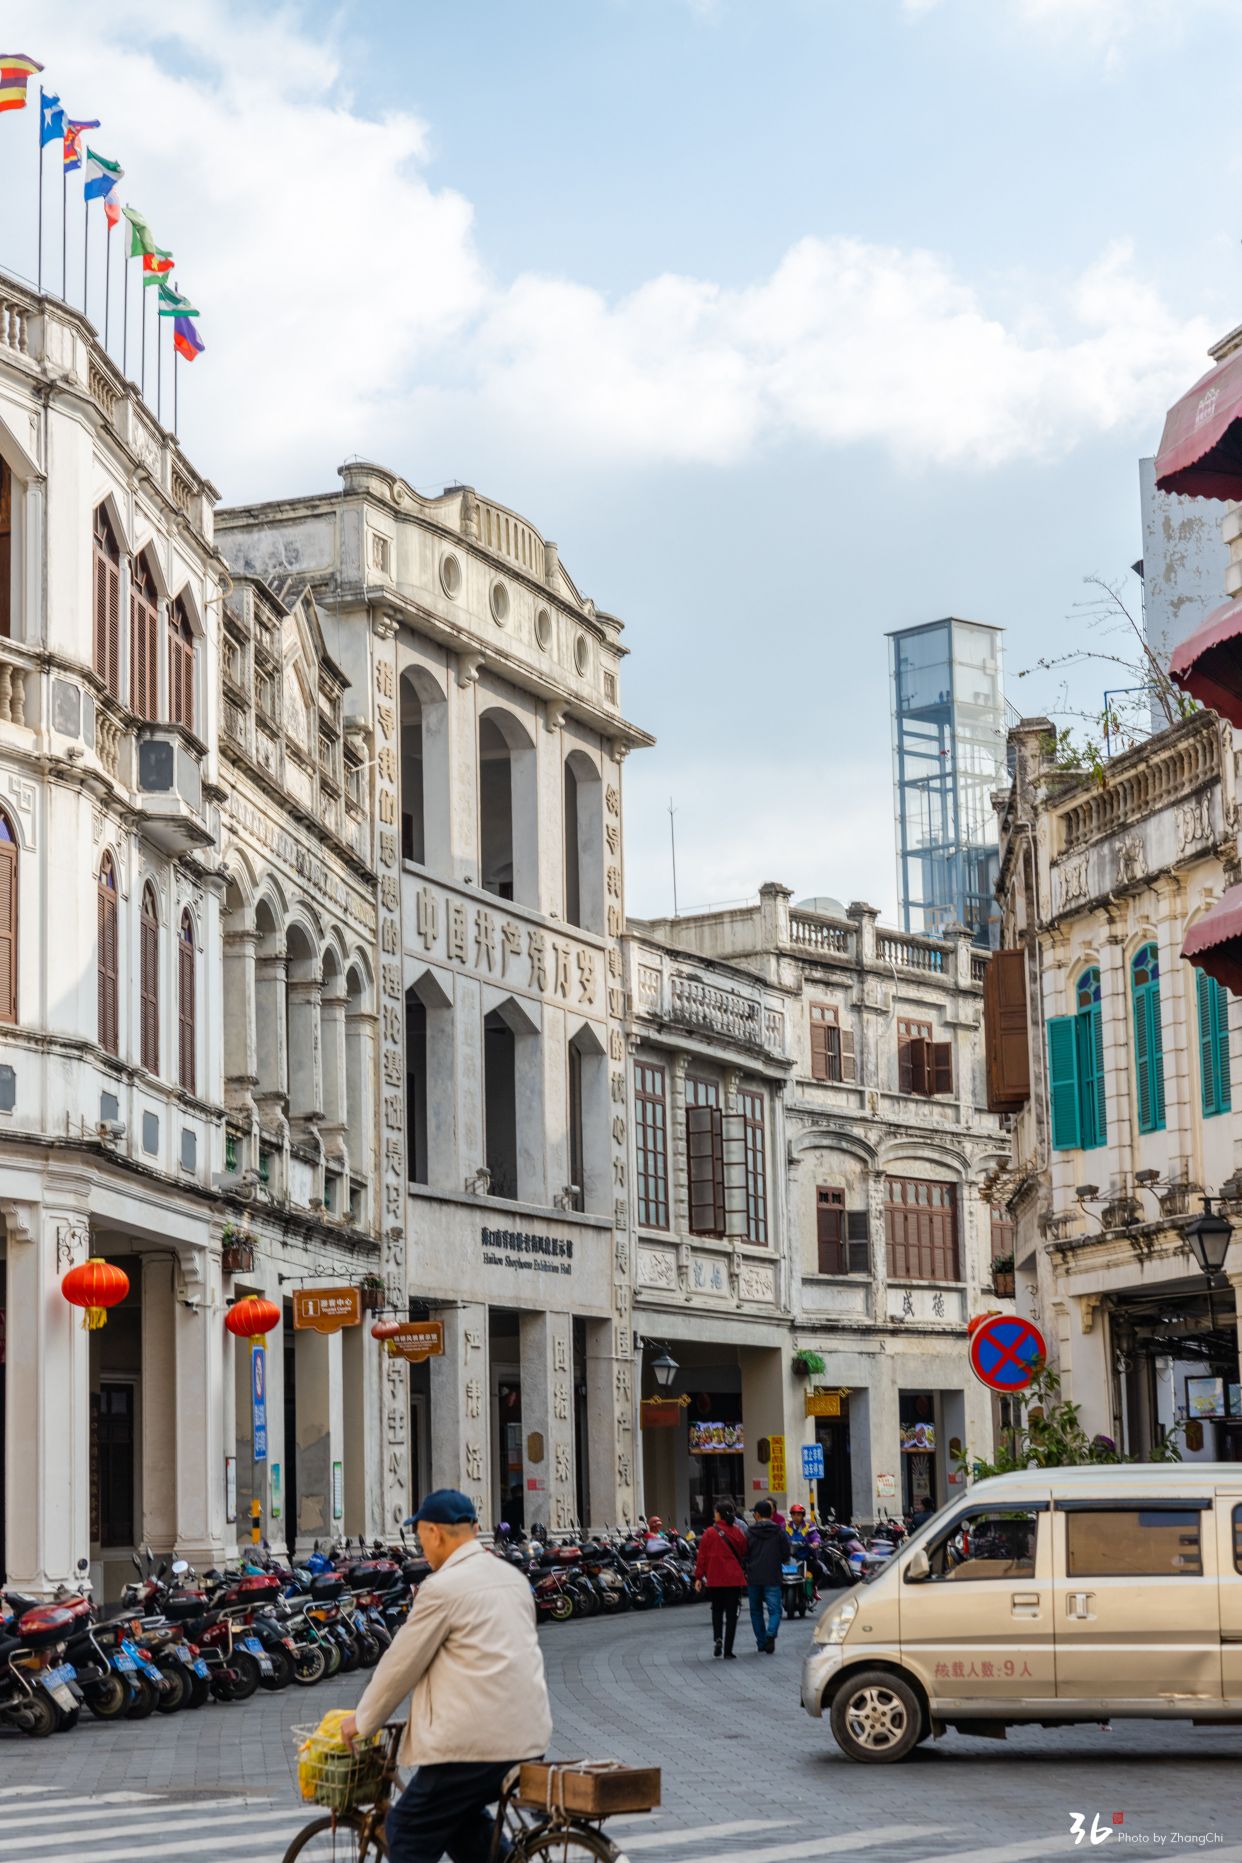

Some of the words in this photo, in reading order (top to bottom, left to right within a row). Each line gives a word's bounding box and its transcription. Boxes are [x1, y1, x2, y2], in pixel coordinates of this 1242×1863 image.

[376, 659, 404, 1524] 指导我们思想的理论基础是马克思宁主义。
[416, 886, 597, 1004] 中国共产党万岁
